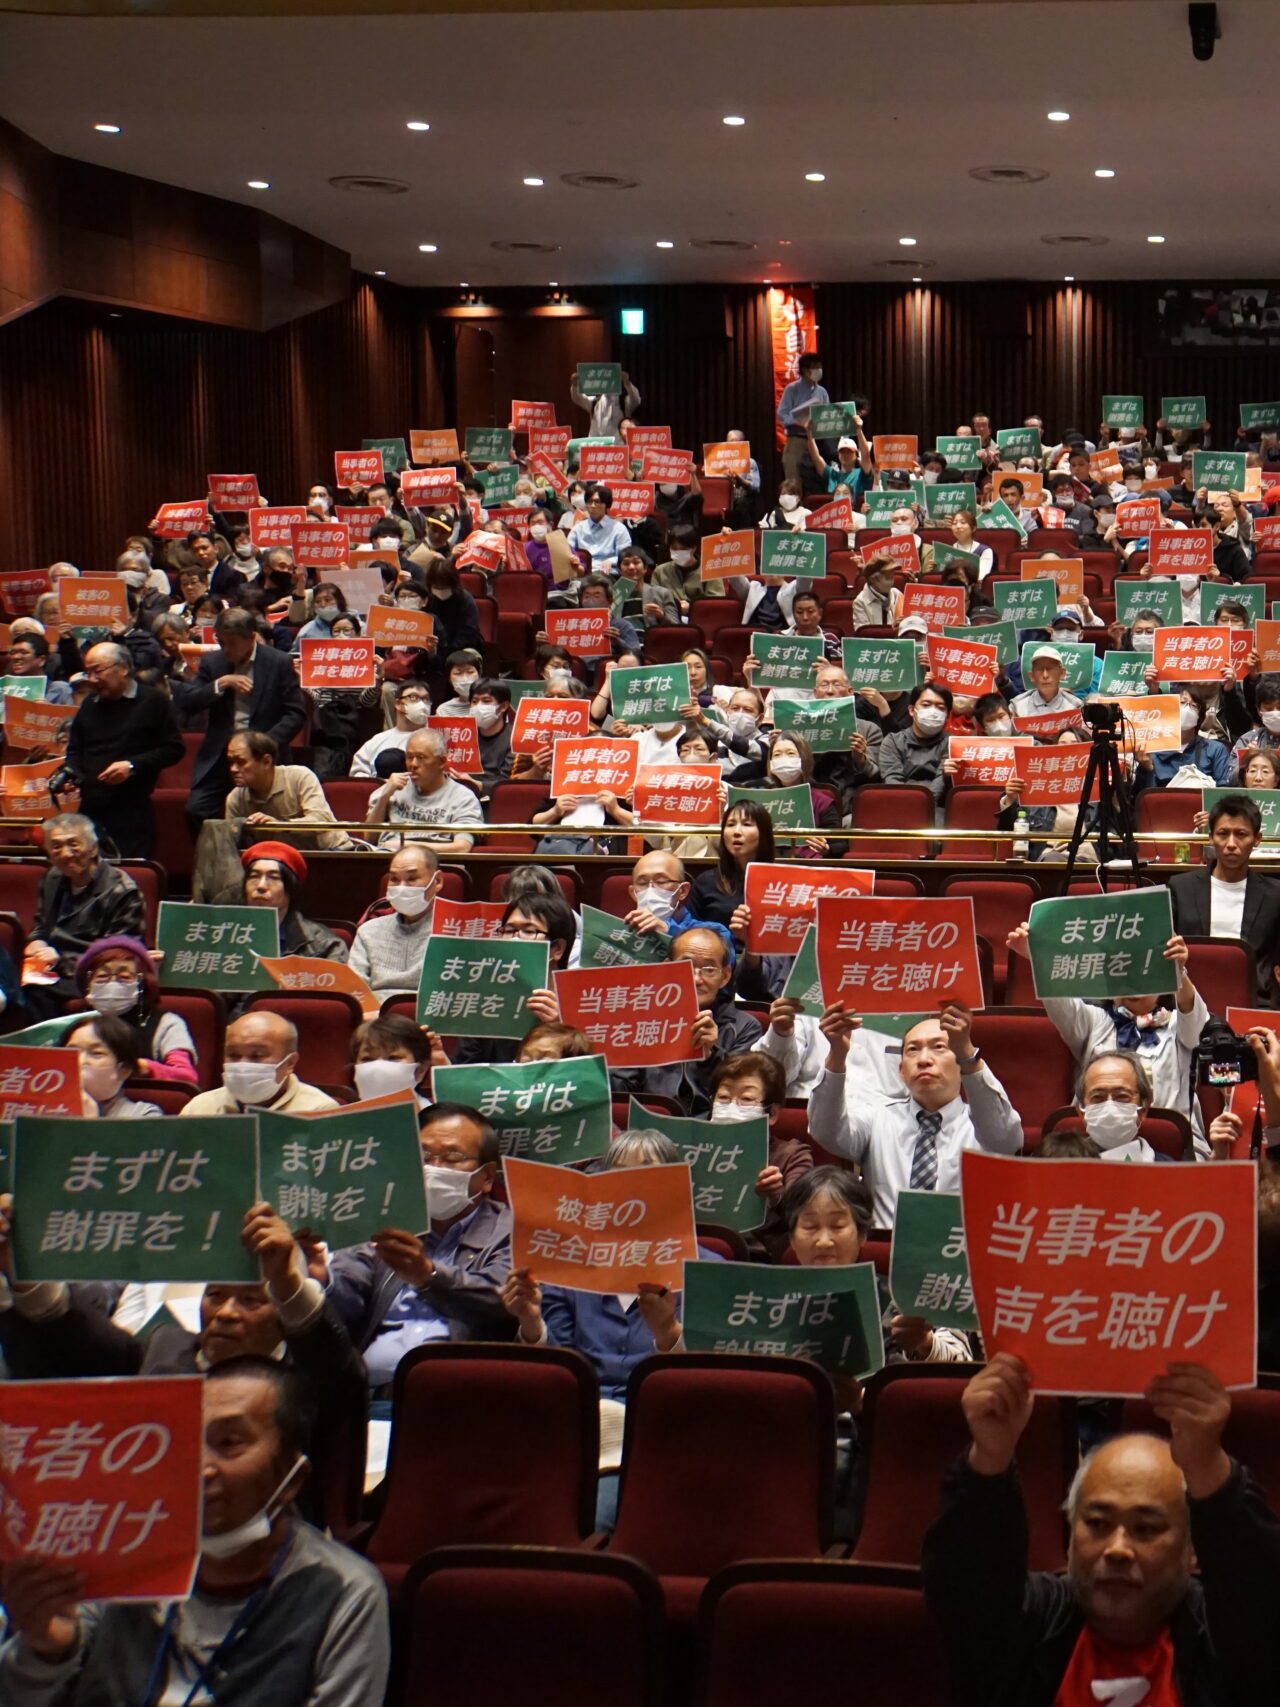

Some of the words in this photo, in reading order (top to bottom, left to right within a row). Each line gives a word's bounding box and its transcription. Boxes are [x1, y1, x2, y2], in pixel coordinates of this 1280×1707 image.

[777, 539, 814, 552] まずは
[1159, 538, 1206, 550] 当事者の
[769, 555, 816, 568] 謝罪を！
[1157, 554, 1207, 566] 声を聴け
[910, 594, 958, 608] 当事者の
[1007, 589, 1043, 603] まずは
[1130, 591, 1168, 603] まずは
[556, 618, 603, 630] 当事者の
[1001, 607, 1047, 623] 謝罪を！
[557, 635, 604, 647] 声を聴け
[1163, 637, 1223, 651] 当事者の
[312, 648, 367, 660] 当事者の
[768, 646, 809, 660] まずは
[858, 650, 900, 663] まずは
[935, 648, 989, 670] 当事者の
[311, 665, 368, 678] 声を聴け
[761, 664, 815, 679] 謝罪を！
[1162, 656, 1225, 670] 声を聴け
[628, 676, 673, 693] まずは
[852, 668, 904, 683] 謝罪を！
[622, 697, 678, 716] 謝罪を！
[792, 706, 838, 724] まずは
[525, 709, 581, 724] 当事者の
[565, 748, 630, 764] 当事者の
[563, 769, 629, 784] 声を聴け
[646, 774, 712, 790] 当事者の
[645, 795, 712, 812] 声を聴け
[185, 922, 256, 944] まずは
[837, 920, 958, 951] 当事者の
[1061, 913, 1143, 943] まずは
[172, 950, 259, 976] 謝罪を！
[440, 957, 520, 983] まずは
[1051, 950, 1152, 979] 謝罪を！
[837, 962, 964, 991] 声を聴け
[424, 991, 525, 1018] 謝罪を！
[578, 983, 682, 1012] 当事者の
[0, 1067, 65, 1094] 者の
[480, 1081, 576, 1115] まずは
[500, 1121, 586, 1156] 罪を！
[282, 1137, 379, 1176] まずは
[682, 1143, 743, 1175] ずは
[65, 1149, 209, 1193] まずは
[694, 1182, 749, 1214] を！
[556, 1195, 646, 1230] 被害の
[42, 1211, 220, 1251] 謝罪を！
[988, 1204, 1224, 1266] 当事者の
[528, 1226, 682, 1267] 完全回復を
[728, 1291, 838, 1327] まずは
[993, 1288, 1227, 1349] 声を聴け
